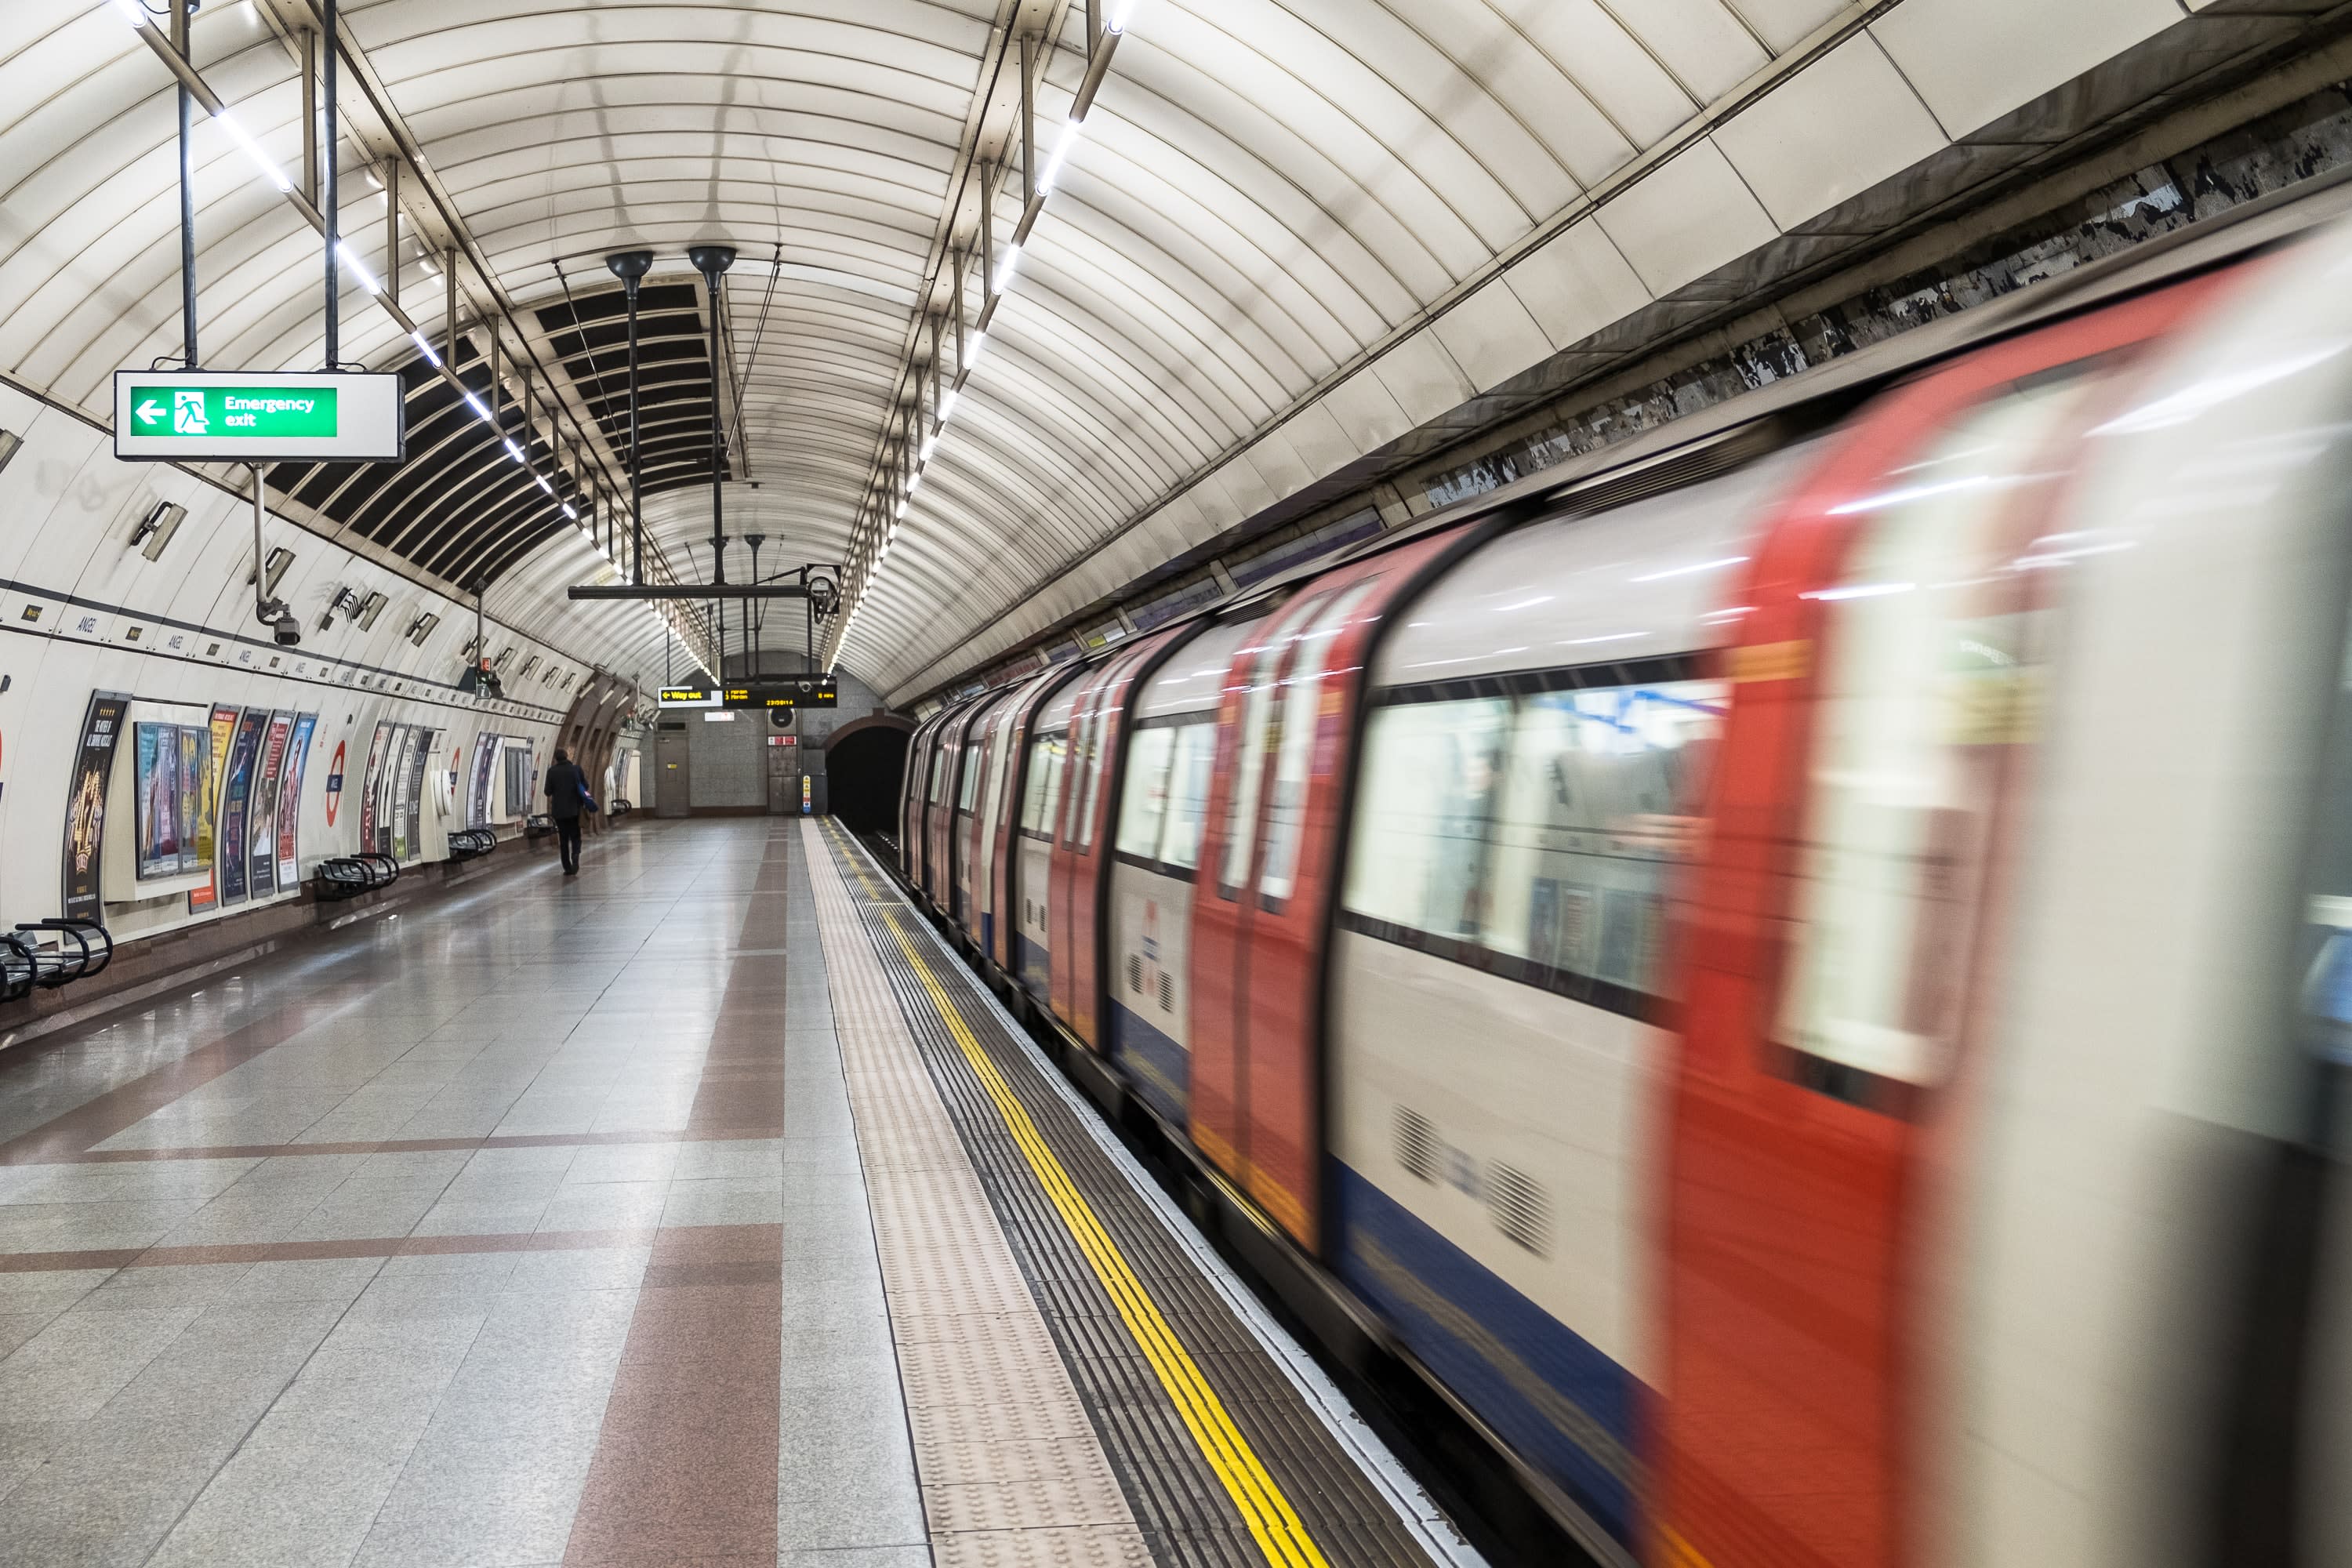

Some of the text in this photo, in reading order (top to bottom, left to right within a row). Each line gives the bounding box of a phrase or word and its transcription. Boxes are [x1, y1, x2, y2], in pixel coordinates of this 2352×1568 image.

[225, 396, 314, 414] Emergency
[224, 412, 256, 427] exit
[76, 615, 97, 633] ANGEL
[168, 635, 183, 649] ANGEL
[671, 691, 702, 700] Way out
